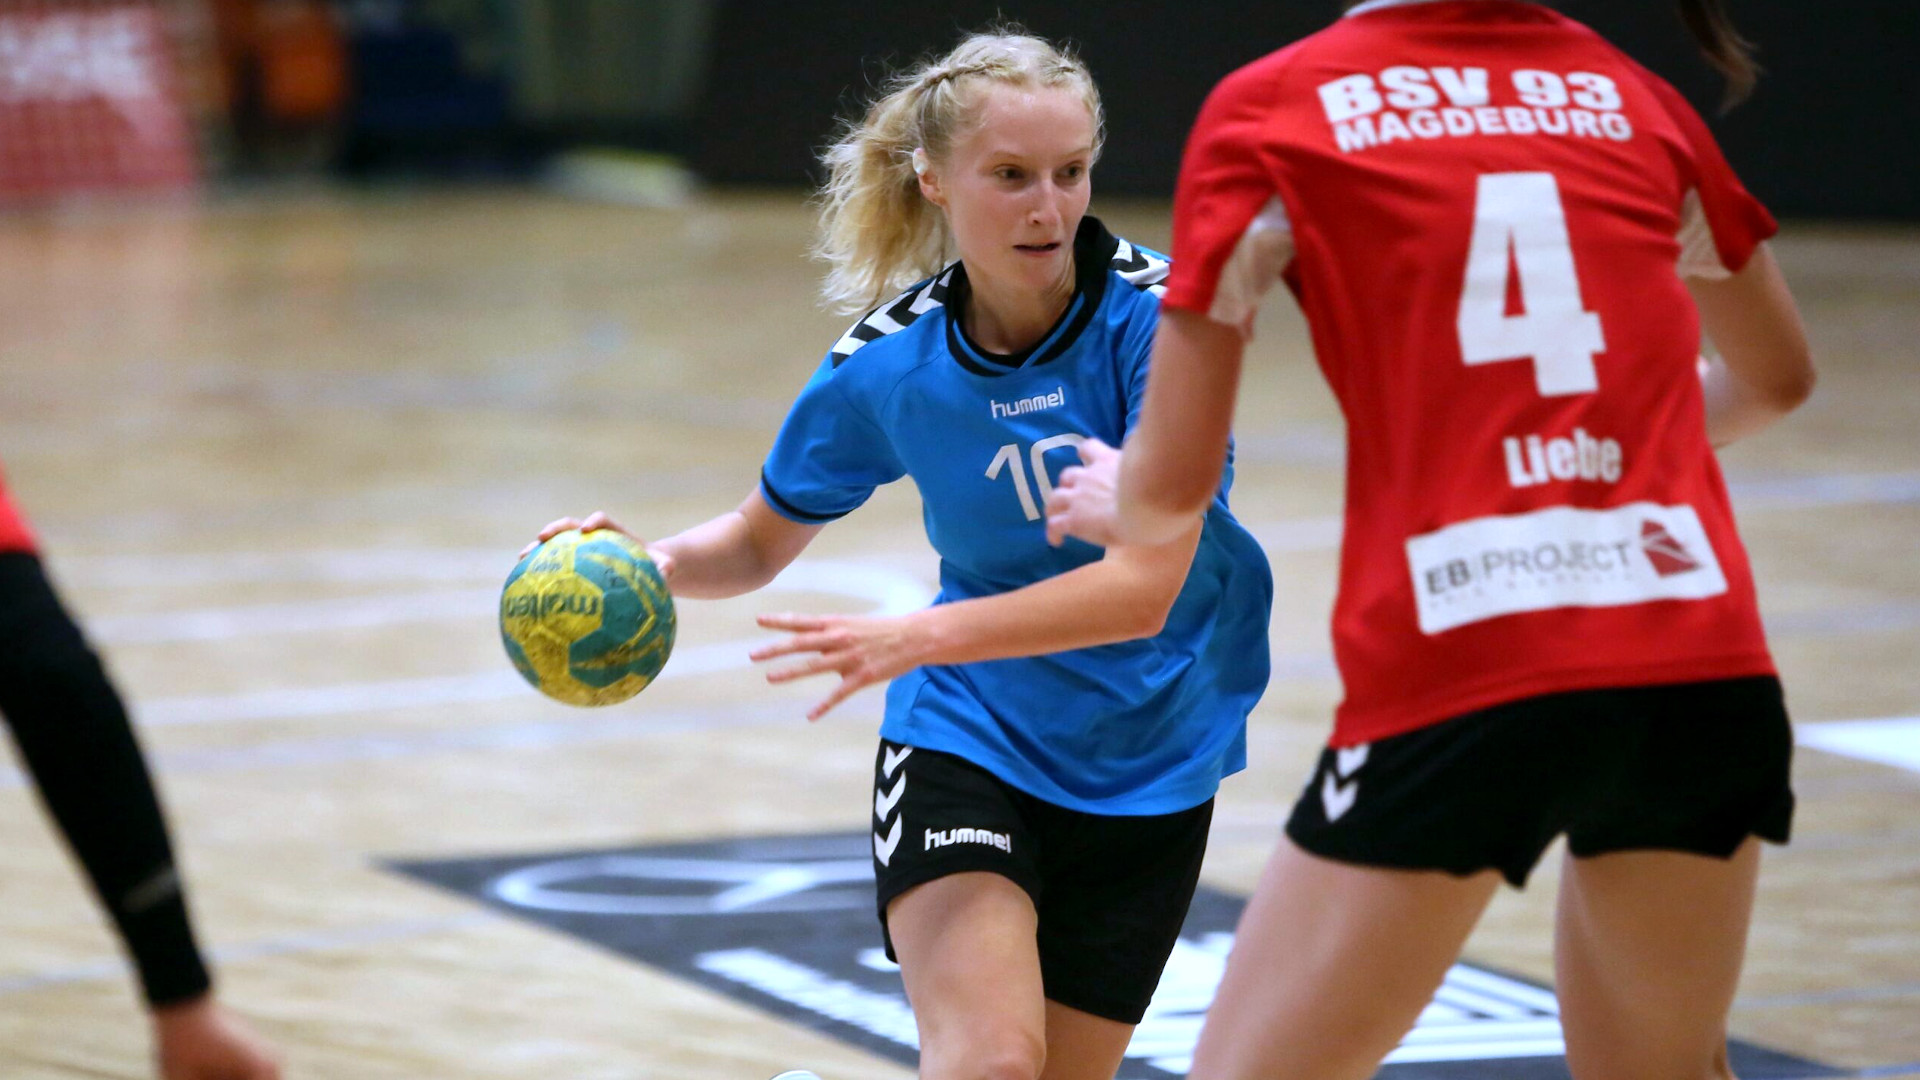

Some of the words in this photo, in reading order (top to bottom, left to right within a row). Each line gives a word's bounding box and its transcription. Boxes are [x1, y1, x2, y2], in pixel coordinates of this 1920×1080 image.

[1317, 65, 1490, 123] BSV
[1510, 69, 1623, 111] 93
[1333, 106, 1633, 153] MAGDEBURG
[1456, 171, 1606, 397] 4
[990, 386, 1065, 419] hummel
[1503, 427, 1623, 487] Liebe
[924, 828, 1012, 854] hummel
